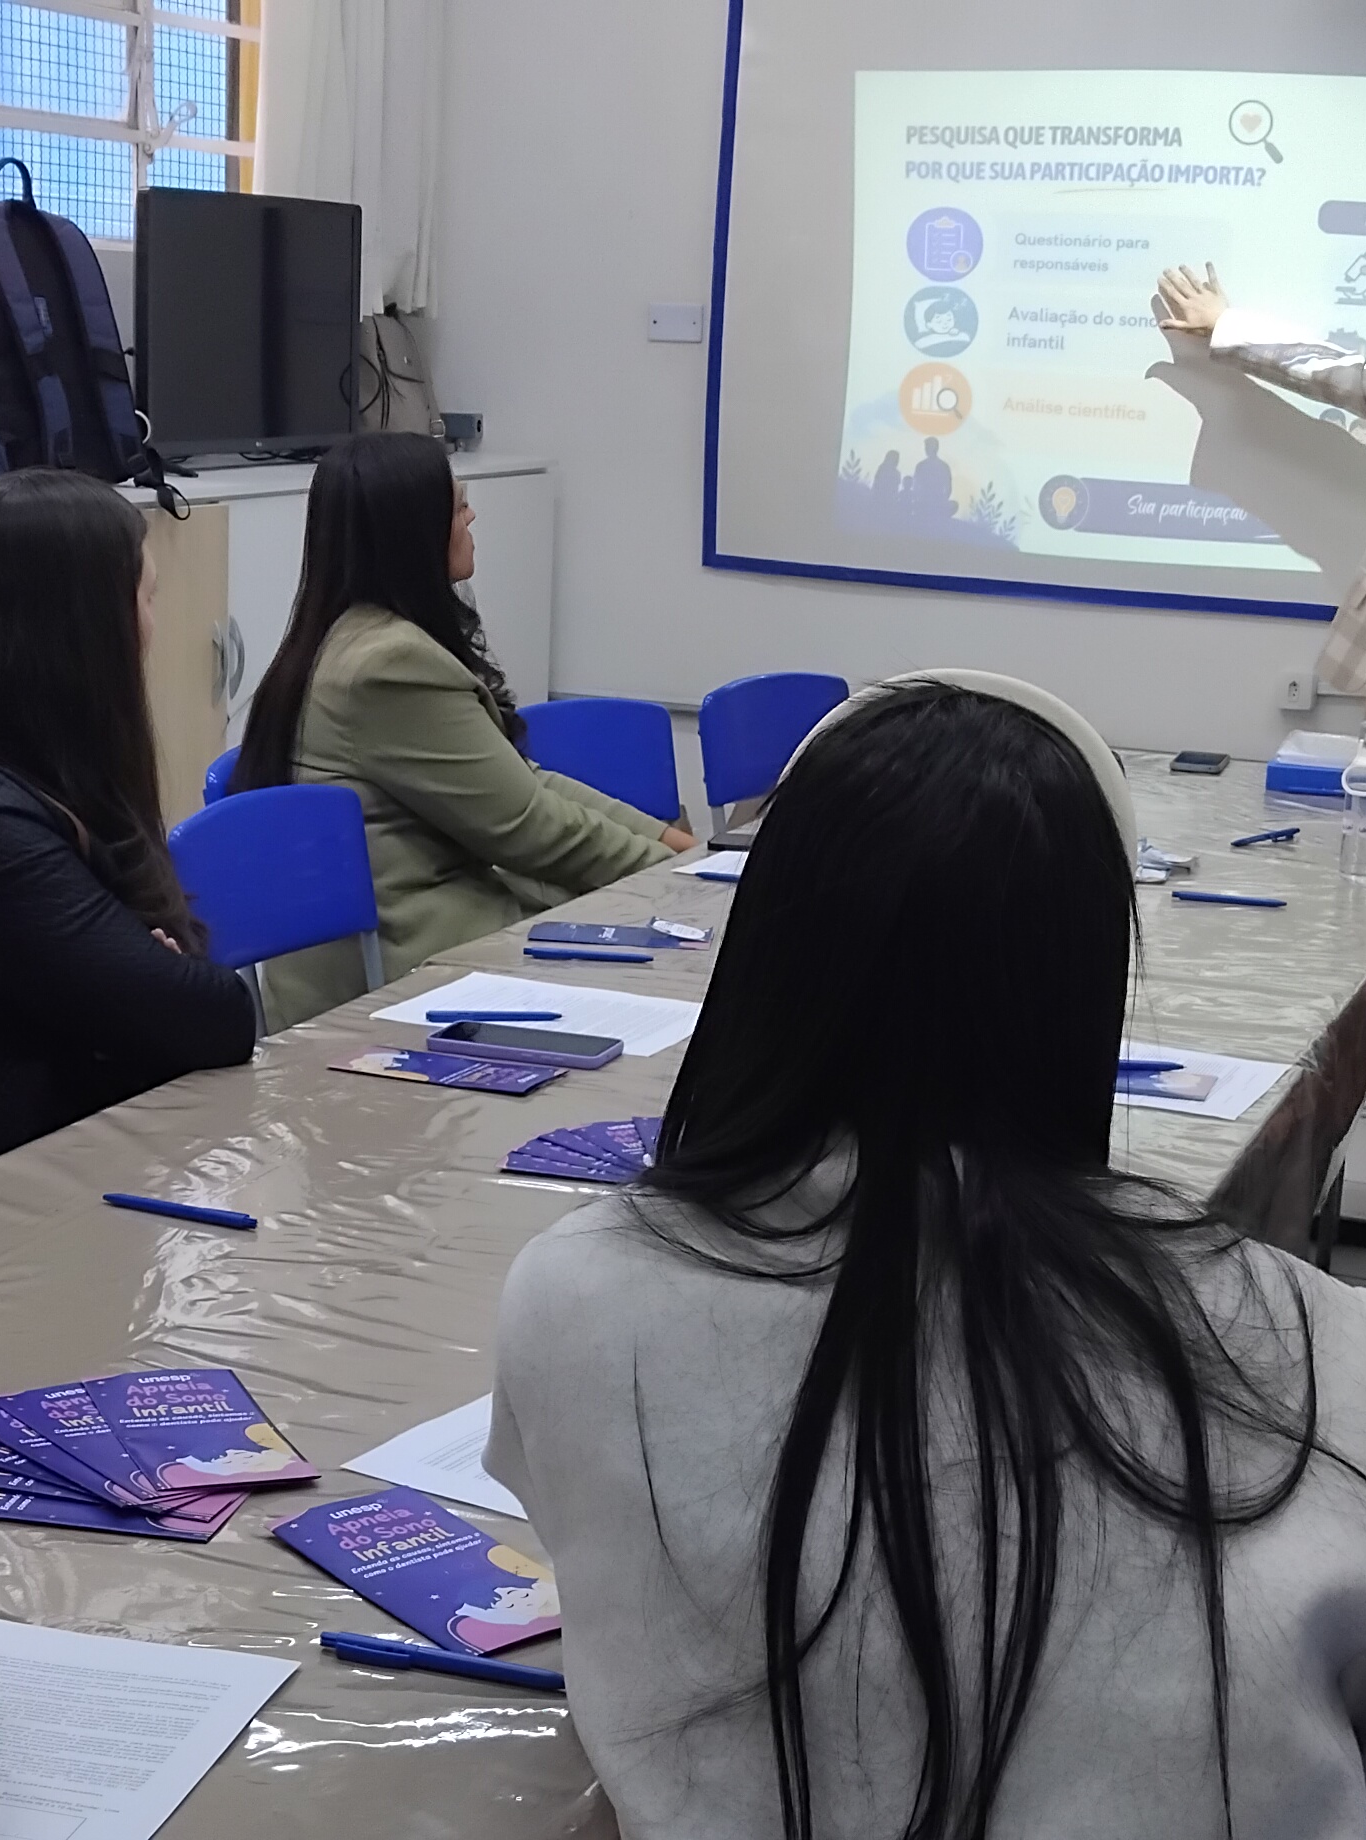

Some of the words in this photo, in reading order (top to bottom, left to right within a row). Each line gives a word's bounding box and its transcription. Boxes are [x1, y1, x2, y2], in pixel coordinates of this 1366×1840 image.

[906, 125, 1000, 149] PESQUISA
[1003, 126, 1045, 149] QUE
[1048, 125, 1182, 148] TRANSFORMA
[905, 160, 943, 179] POR
[946, 161, 985, 183] QUE
[988, 162, 1026, 180] SUA
[1030, 159, 1165, 187] PARTICIPAÇÃO
[1167, 164, 1266, 187] IMPORTA?
[1014, 232, 1112, 248] Questionário
[1116, 238, 1150, 251] para
[1013, 258, 1109, 273] responsáveis
[1008, 306, 1088, 328] Avaliação
[1093, 311, 1114, 326] do
[1006, 332, 1065, 350] infantil
[1002, 396, 1063, 415] Análise
[1067, 401, 1147, 421] científica
[1127, 494, 1156, 515] Sua
[125, 1381, 213, 1396] Apneia
[138, 1373, 192, 1384] unesp
[44, 1387, 86, 1399] unes
[125, 1396, 157, 1407] do
[165, 1392, 227, 1405] Sono
[48, 1409, 79, 1419] do
[133, 1401, 234, 1418] Infantil
[329, 1501, 383, 1519] unesp
[327, 1508, 414, 1536] Apneia
[339, 1535, 372, 1550] do
[373, 1517, 437, 1539] Sono
[351, 1559, 388, 1575] Entenda
[389, 1555, 401, 1563] as
[435, 1533, 473, 1549] sintomas
[352, 1526, 455, 1562] Infantil
[363, 1568, 387, 1579] como
[395, 1555, 432, 1570] dentista
[432, 1548, 454, 1560] pode
